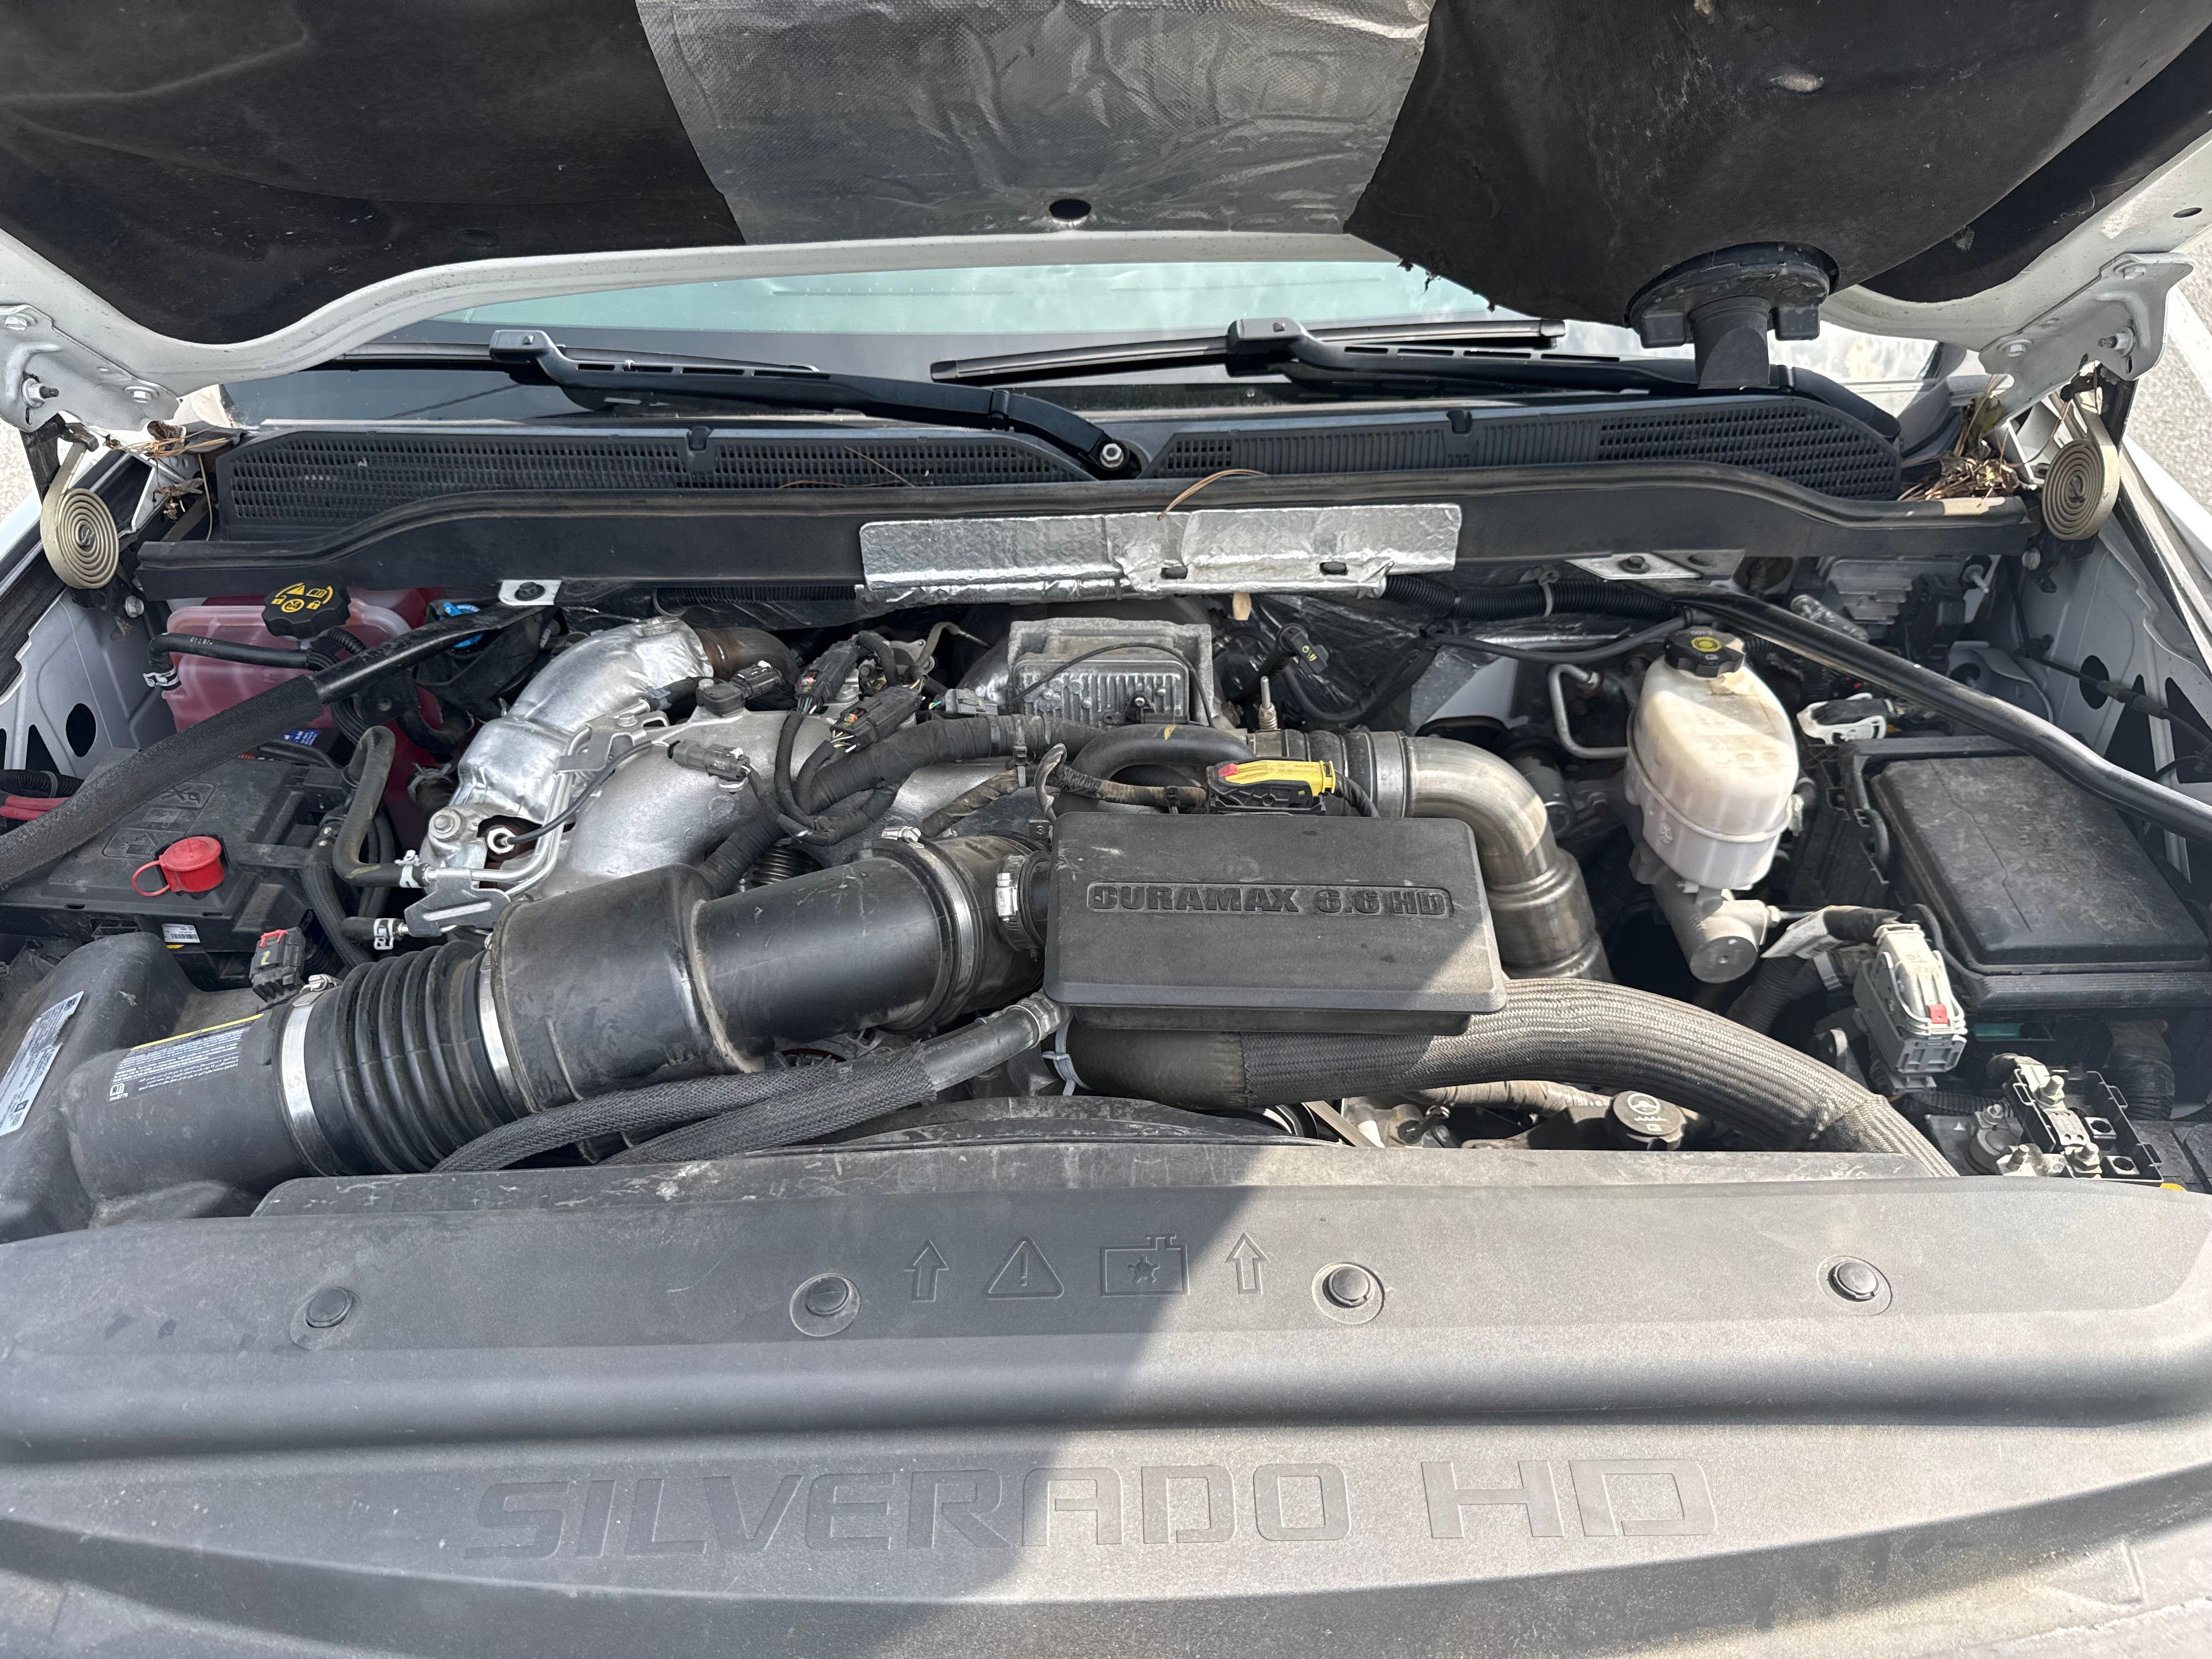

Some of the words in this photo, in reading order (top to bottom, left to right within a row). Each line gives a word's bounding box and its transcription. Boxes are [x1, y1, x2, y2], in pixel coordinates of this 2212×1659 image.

[1093, 885, 1299, 912] DURAMAX
[1317, 889, 1380, 913] 6.6
[1390, 890, 1447, 916] HD
[464, 1463, 1352, 1560] SILVERADO
[1421, 1458, 1718, 1539] HD
